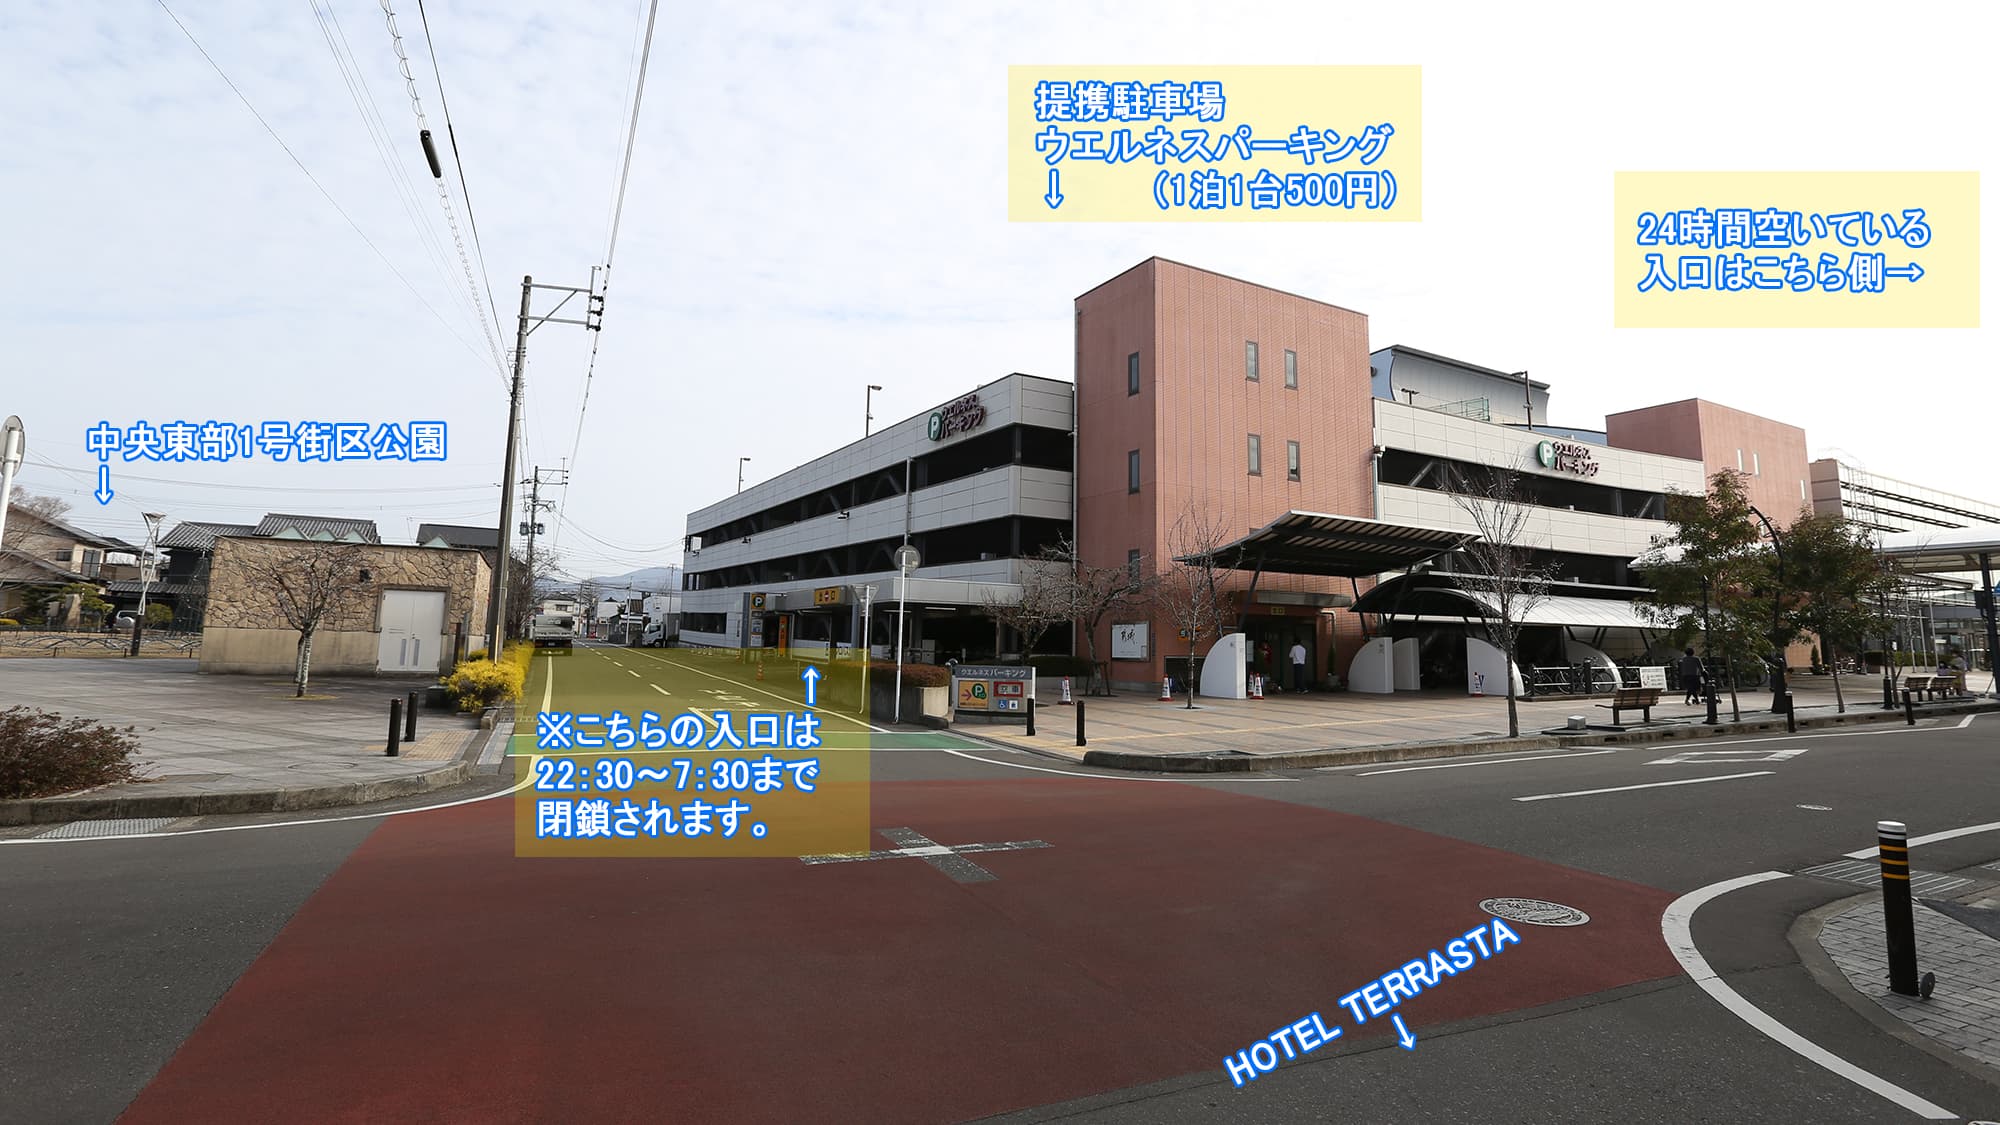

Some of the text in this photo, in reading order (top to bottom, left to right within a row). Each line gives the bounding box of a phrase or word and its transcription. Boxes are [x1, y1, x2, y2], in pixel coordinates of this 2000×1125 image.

[961, 668, 1026, 678] ウエルネスパーキング
